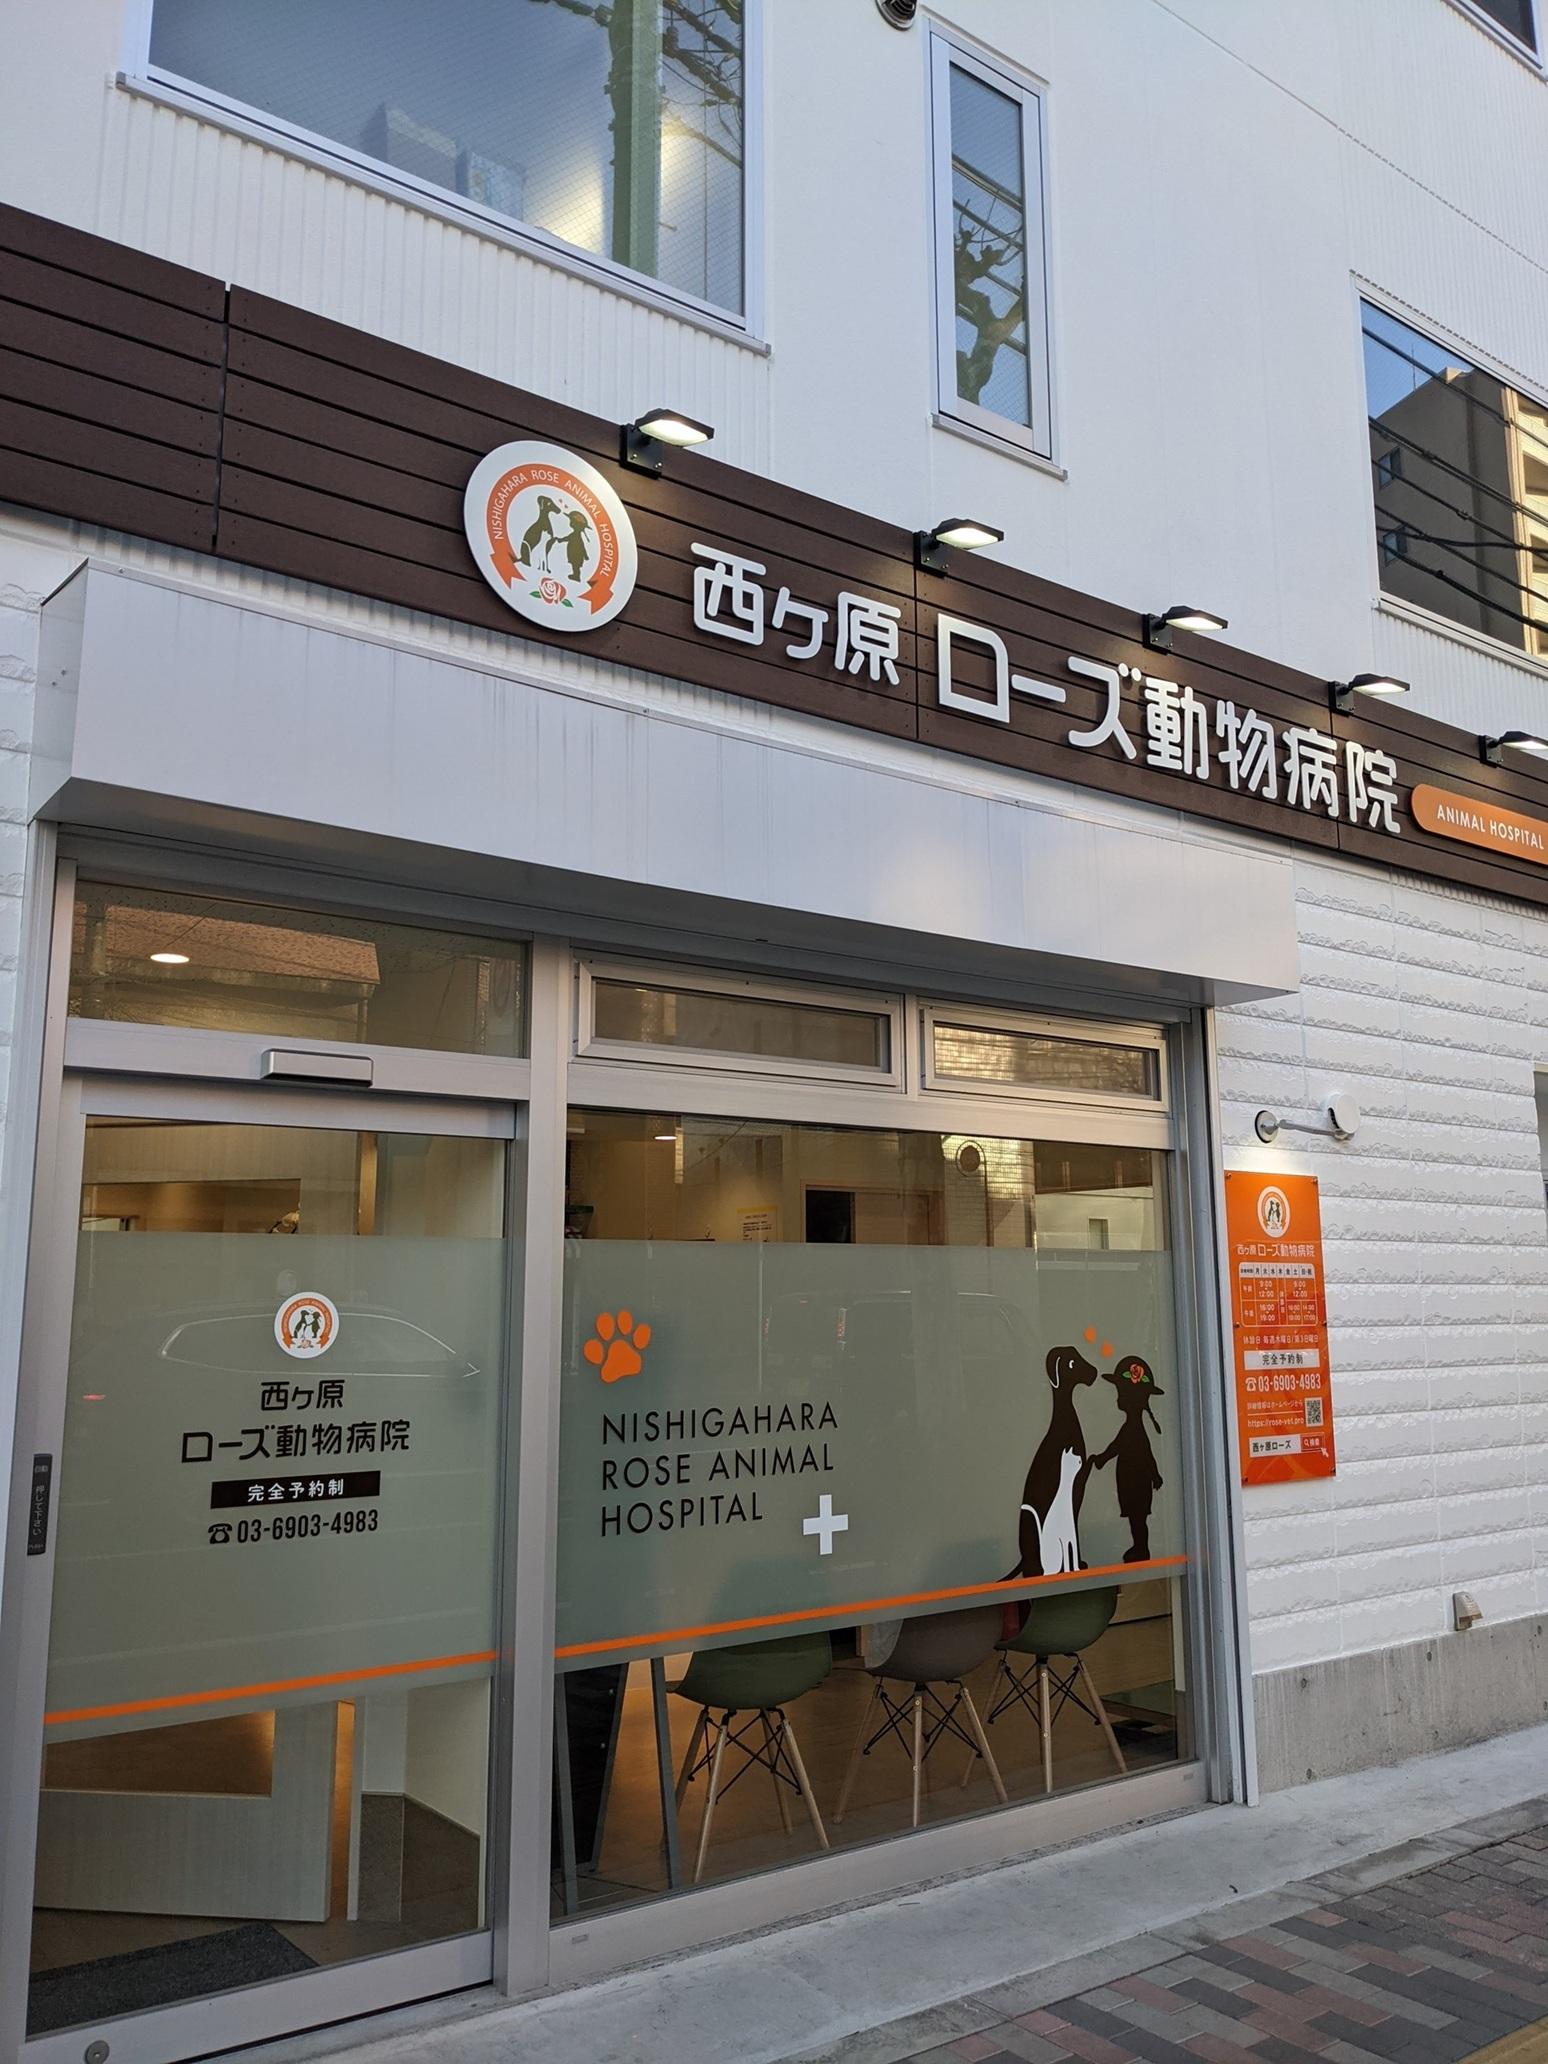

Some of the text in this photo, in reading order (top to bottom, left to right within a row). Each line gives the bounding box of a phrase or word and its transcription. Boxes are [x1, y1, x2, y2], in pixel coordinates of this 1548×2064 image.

[492, 469, 614, 577] NISHIGAHARA ROSE ANIMAL HOSPITAL
[937, 612, 1402, 834] ローズ動物病院
[1437, 804, 1544, 850] ANIMAL HOSPITAL
[1262, 1354, 1304, 1365] 完全予約制
[181, 1419, 410, 1463] ローズ動物病院
[602, 1401, 838, 1445] NISHIGAHARA
[602, 1443, 834, 1490] ROSE ANIMAL
[247, 1478, 344, 1503] 完全予約制
[237, 1509, 379, 1544] 03-6903-4983
[601, 1491, 763, 1537] HOSPITAL
